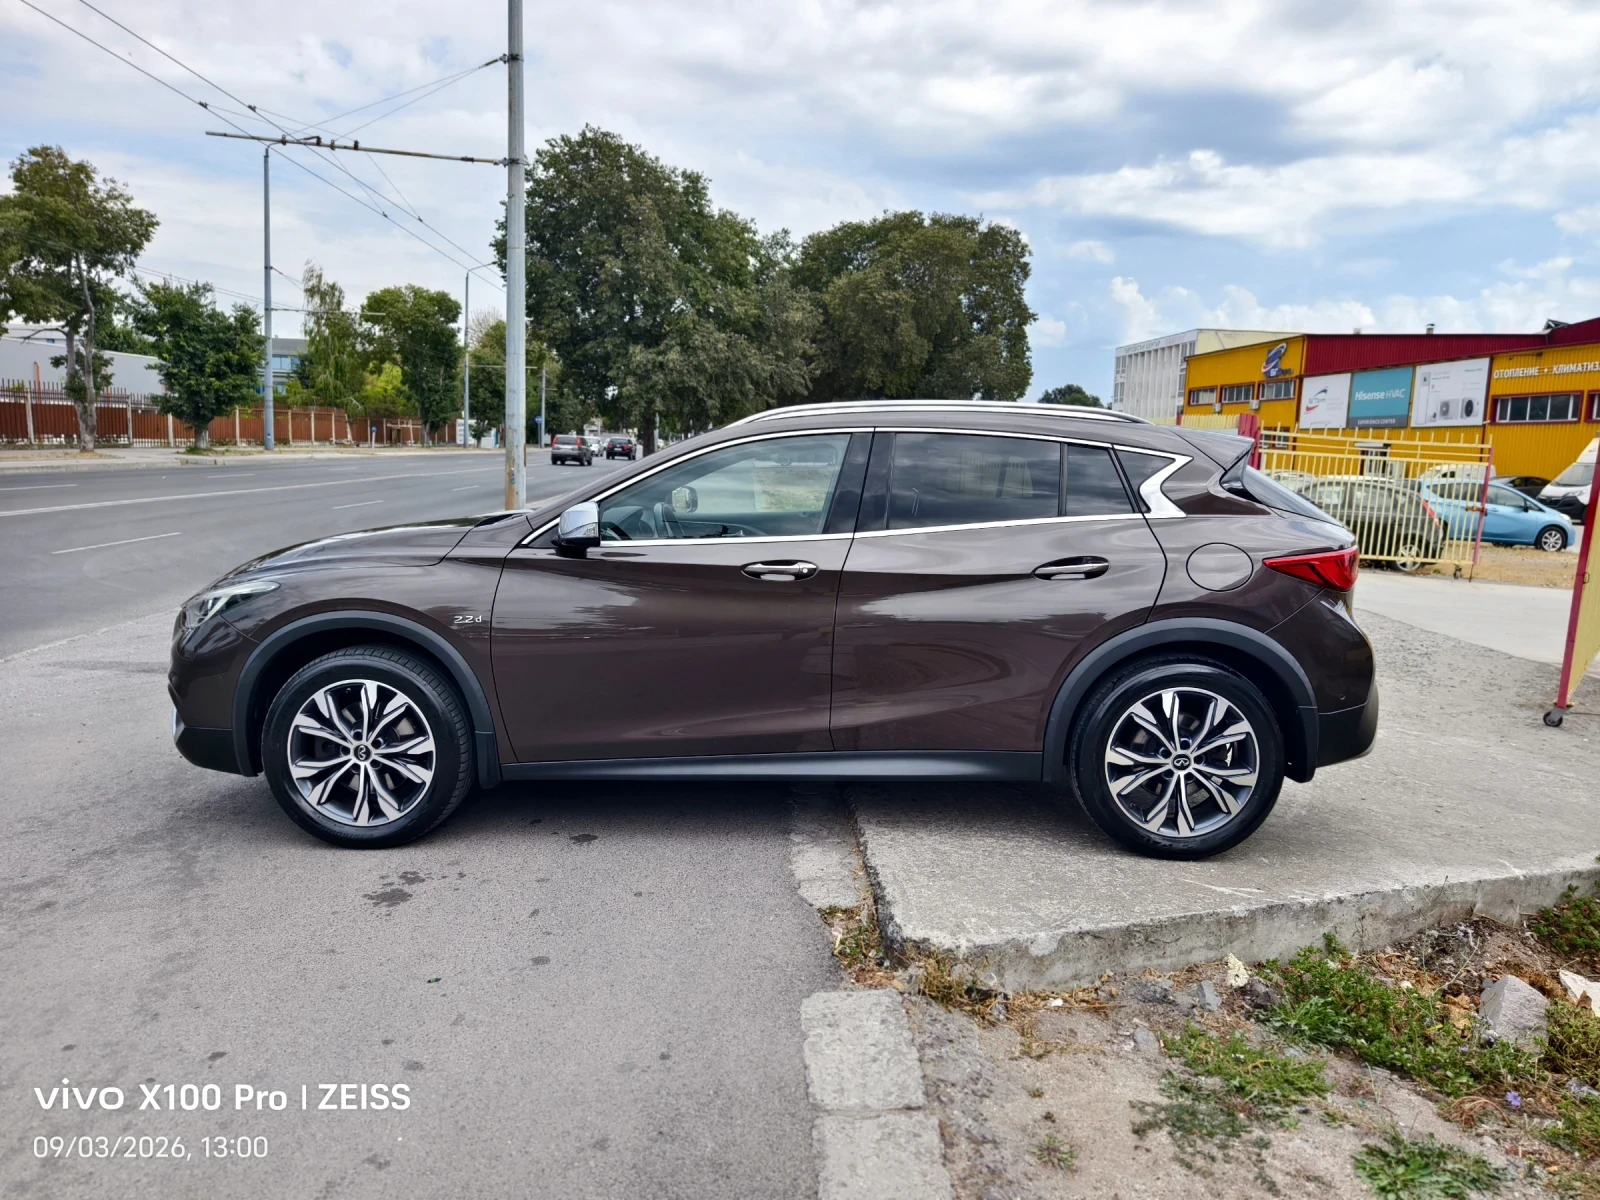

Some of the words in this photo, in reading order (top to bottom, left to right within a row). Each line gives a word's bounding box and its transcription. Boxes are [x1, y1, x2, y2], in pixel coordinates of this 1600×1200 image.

[1493, 366, 1540, 379] ОТОПЛЕНИЕ
[1552, 361, 1600, 374] КЛИМАТИЗ
[1355, 391, 1385, 401] Hisense
[1385, 388, 1406, 399] HVAC
